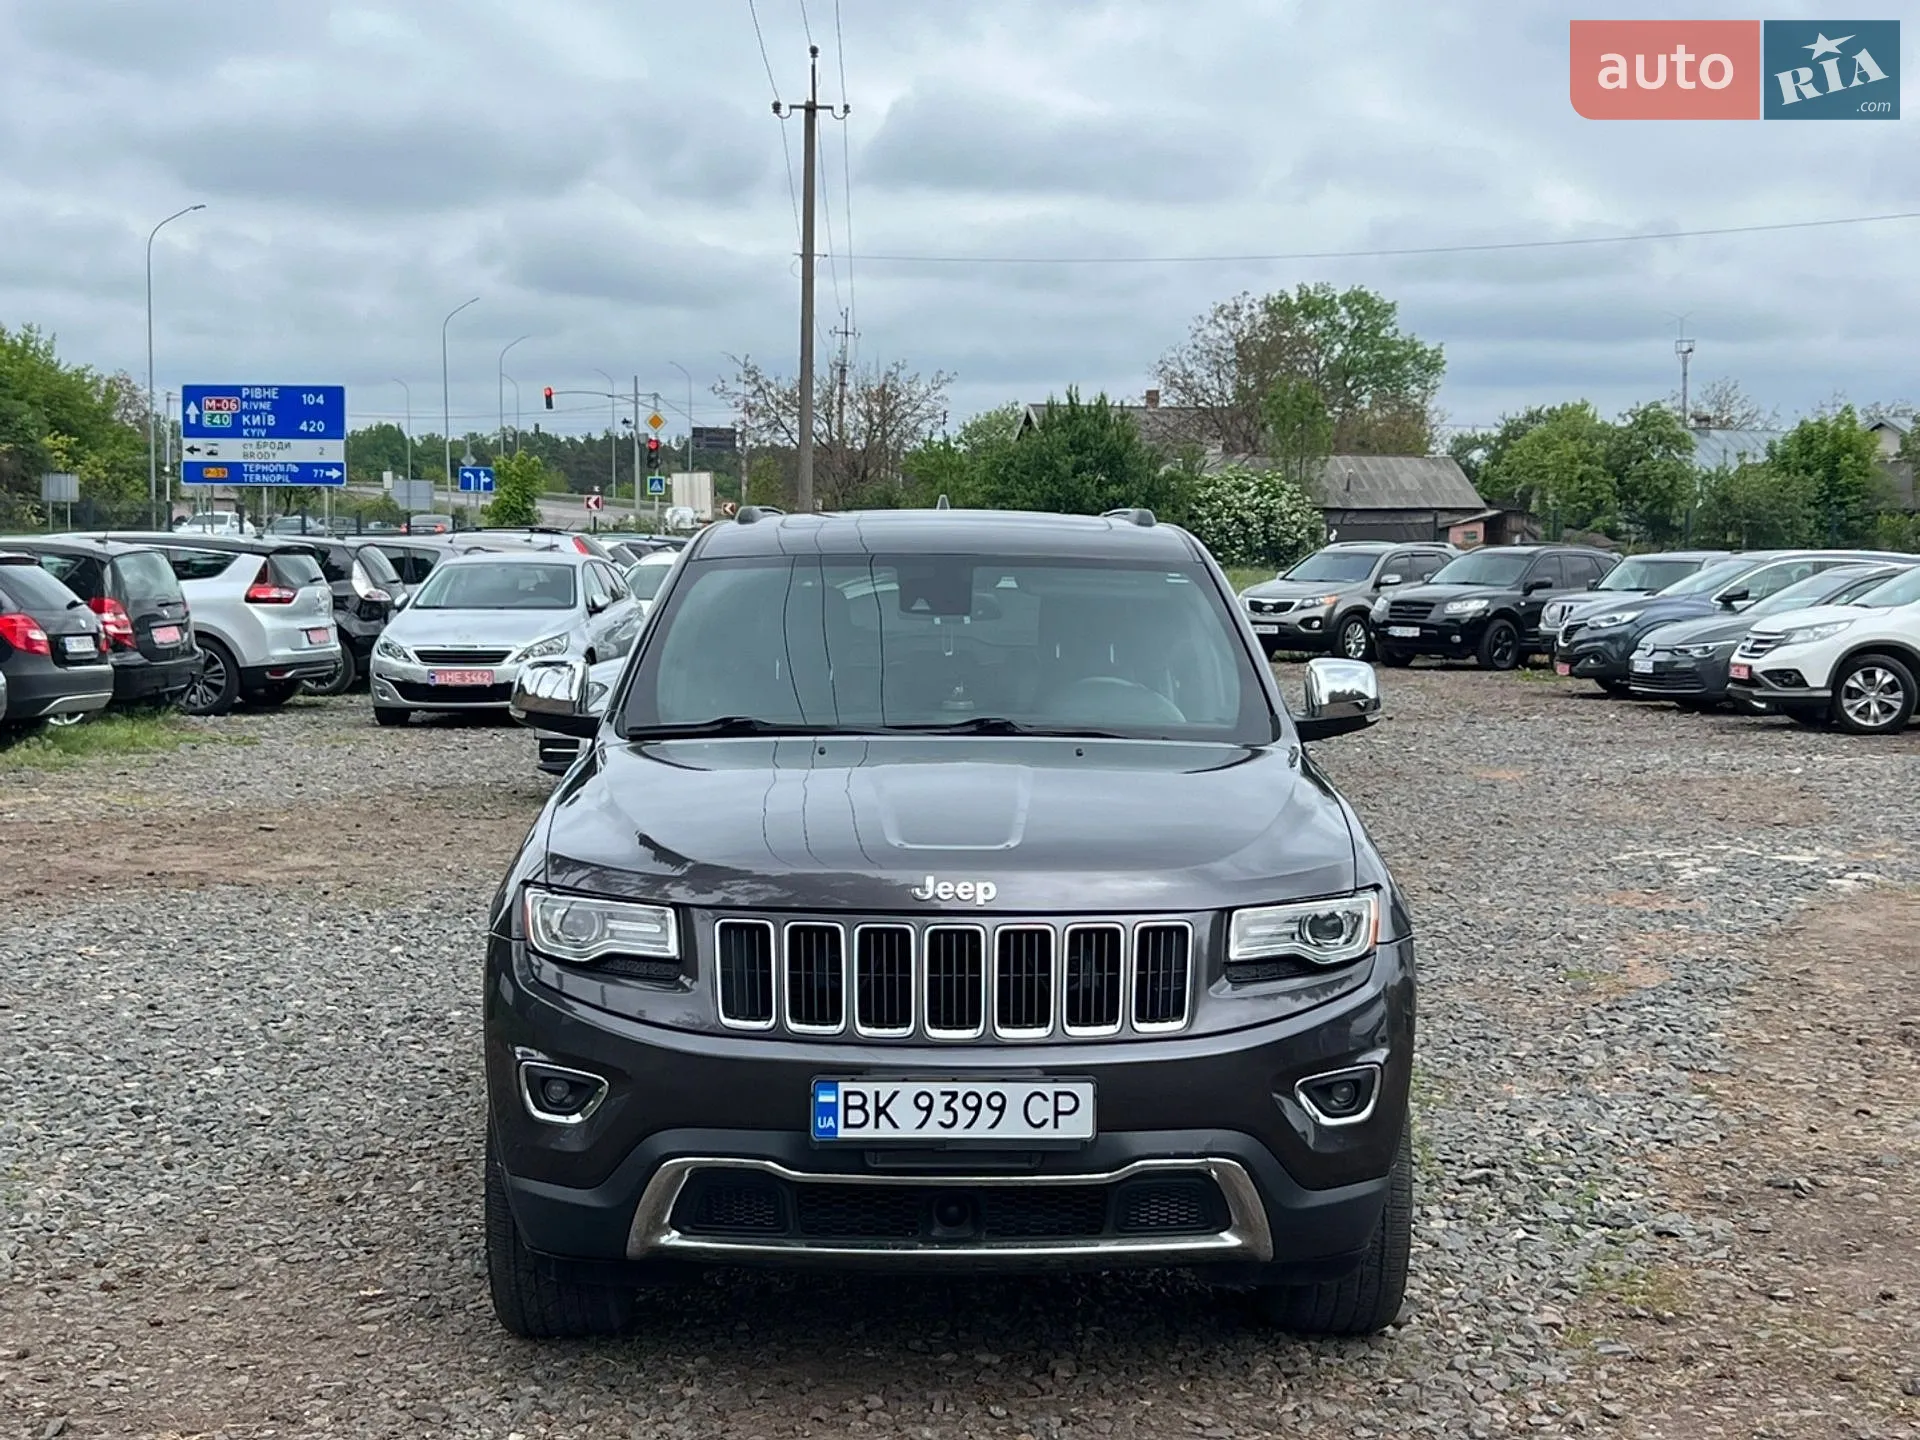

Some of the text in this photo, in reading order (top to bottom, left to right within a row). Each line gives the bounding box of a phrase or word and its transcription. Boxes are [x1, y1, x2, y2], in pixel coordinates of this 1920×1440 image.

[241, 387, 280, 400] РІВНЕ
[301, 393, 325, 406] 104
[205, 399, 238, 411] M-06
[241, 400, 273, 411] RIVNE
[205, 415, 230, 426] E40
[242, 411, 276, 426] КИЇВ
[242, 427, 267, 438] KYIV
[299, 420, 326, 433] 420
[242, 450, 277, 460] BRODY
[318, 446, 325, 456] 2
[910, 875, 997, 907] Jeep
[818, 1090, 1080, 1130] UA BK 9399 CP
